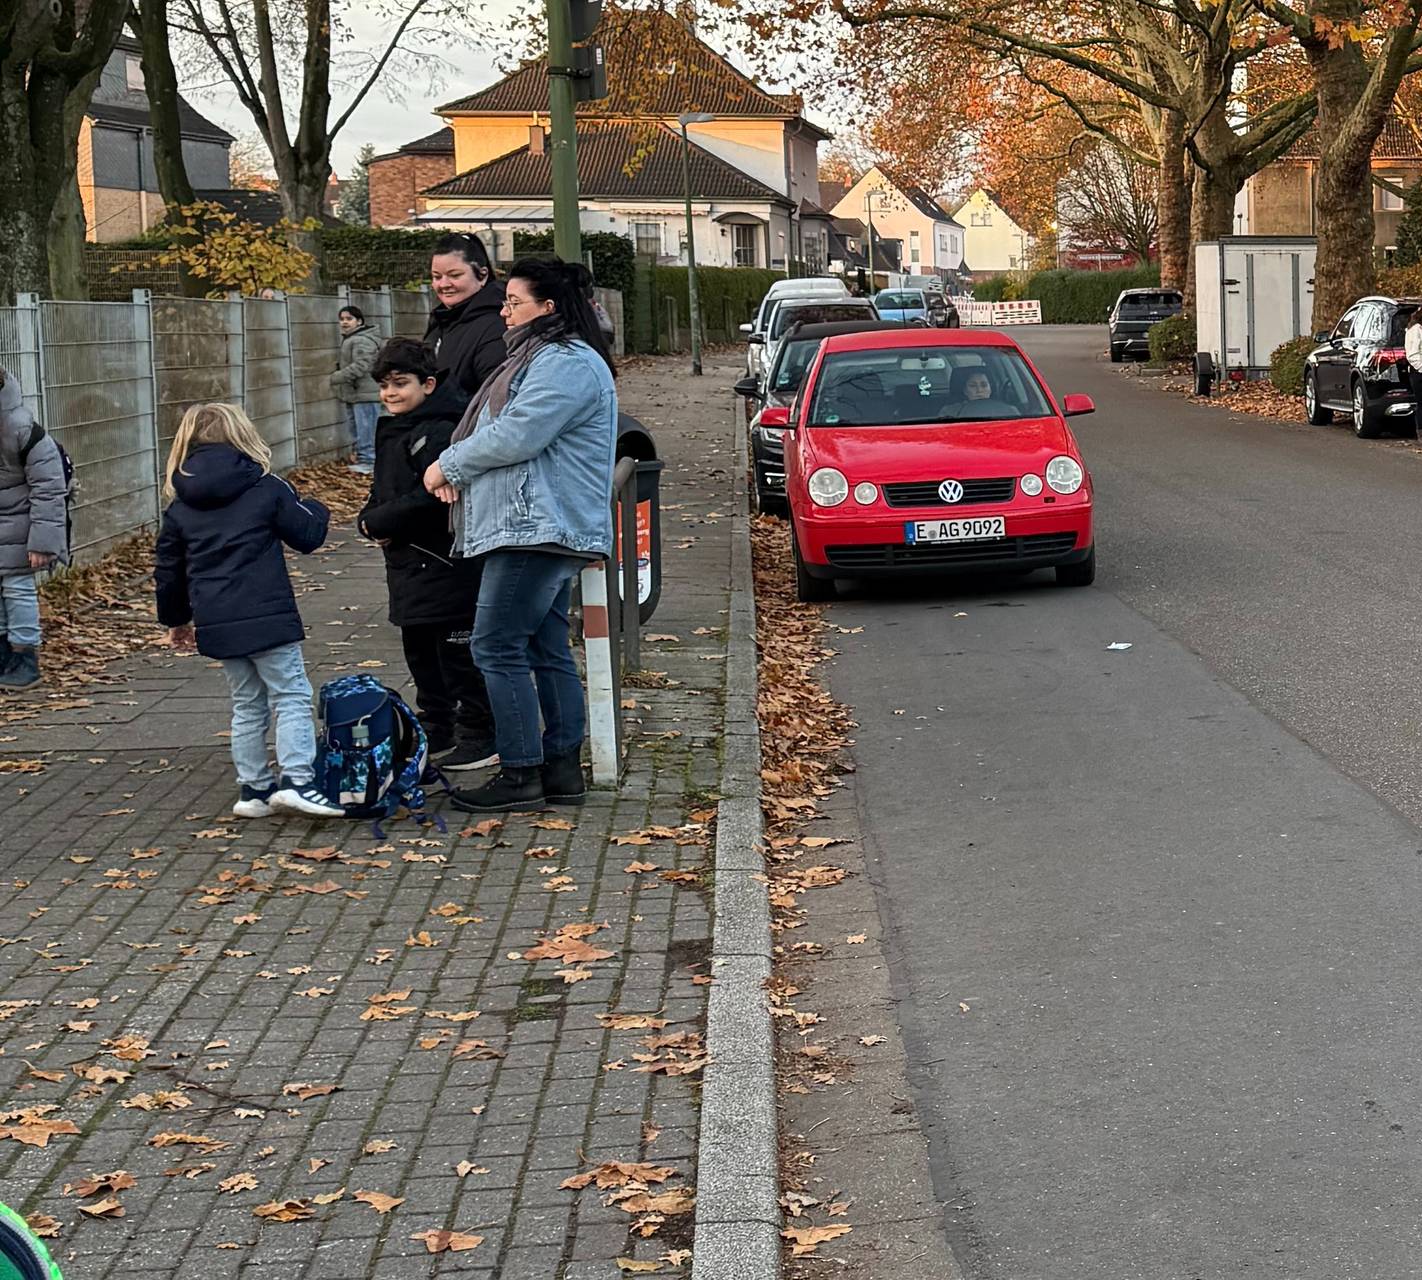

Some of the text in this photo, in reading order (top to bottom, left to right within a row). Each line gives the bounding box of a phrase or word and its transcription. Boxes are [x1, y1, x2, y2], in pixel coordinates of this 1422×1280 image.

[916, 519, 1003, 539] E AG 9092
